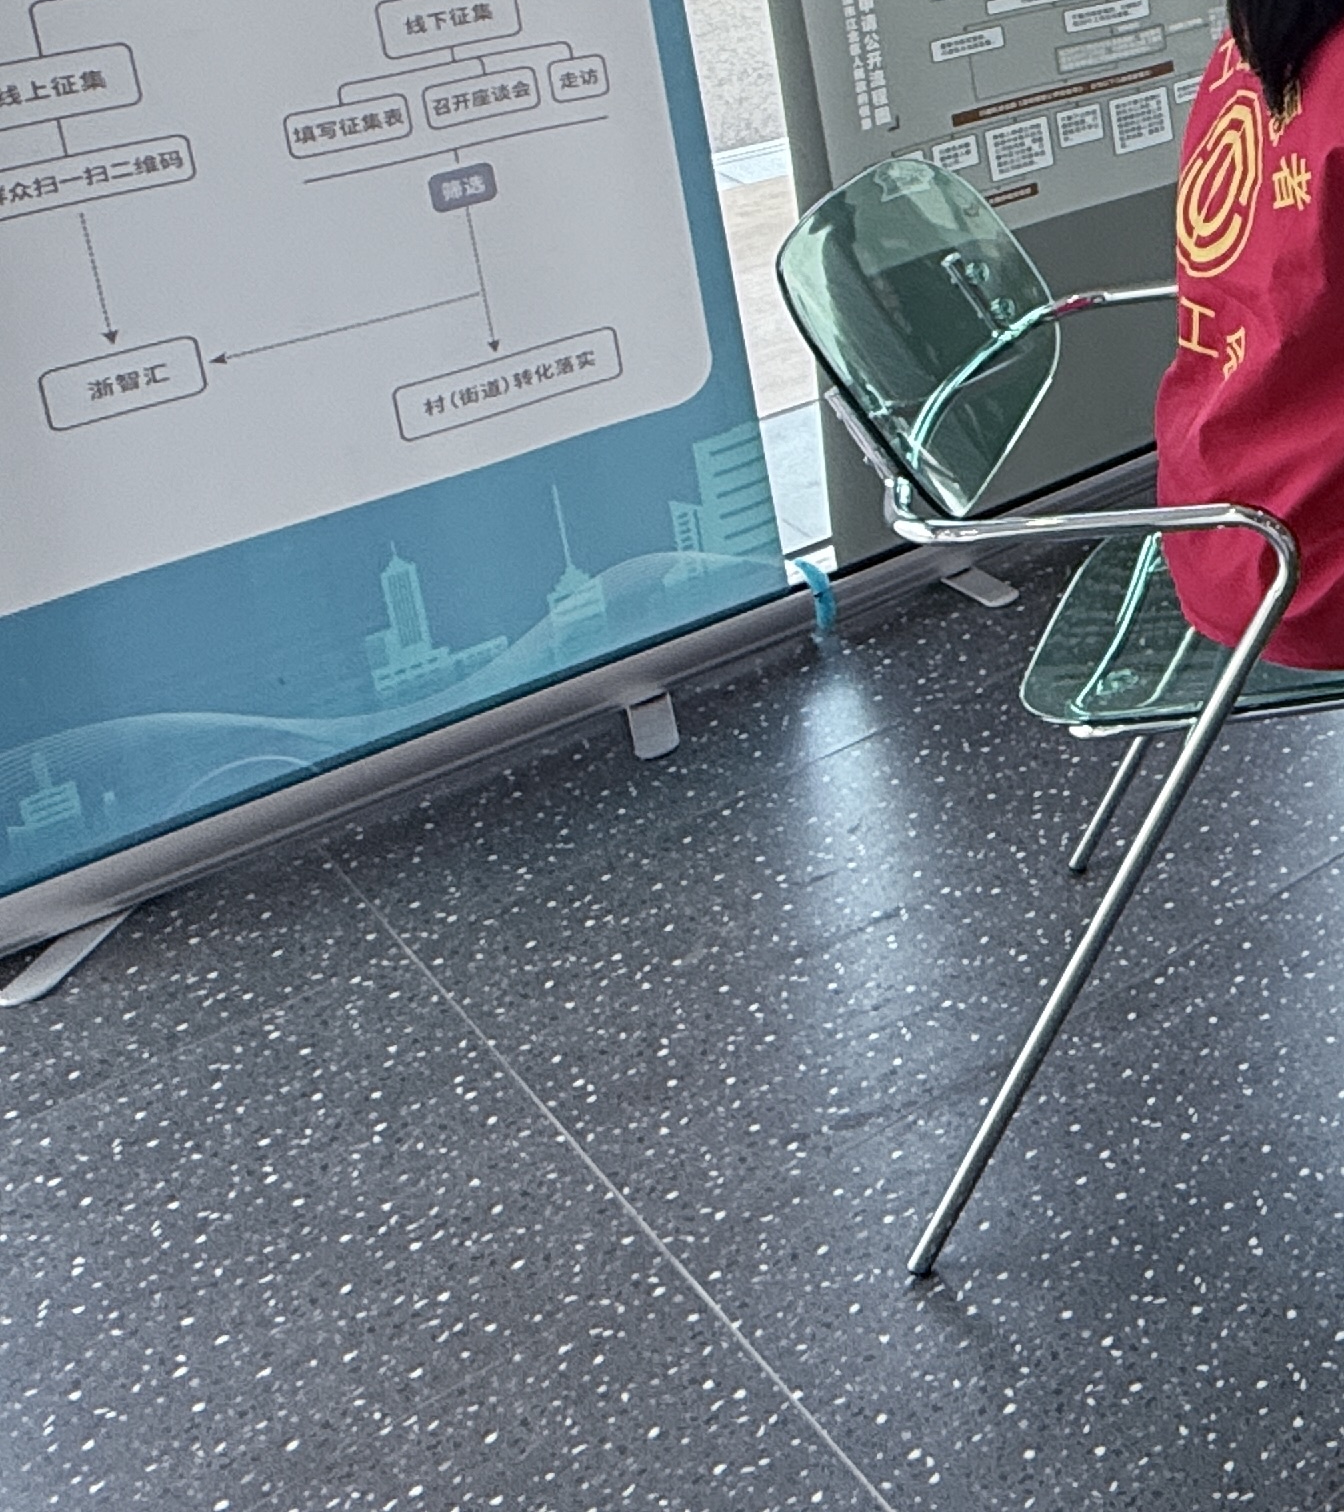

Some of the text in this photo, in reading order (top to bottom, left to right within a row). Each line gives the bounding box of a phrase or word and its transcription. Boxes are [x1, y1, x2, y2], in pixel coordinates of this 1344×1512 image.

[403, 3, 494, 35] 线下征集
[559, 68, 599, 90] 走访
[432, 79, 531, 116] 召开座谈会
[293, 108, 405, 144] 填写征集表
[87, 362, 170, 401] 浙智汇
